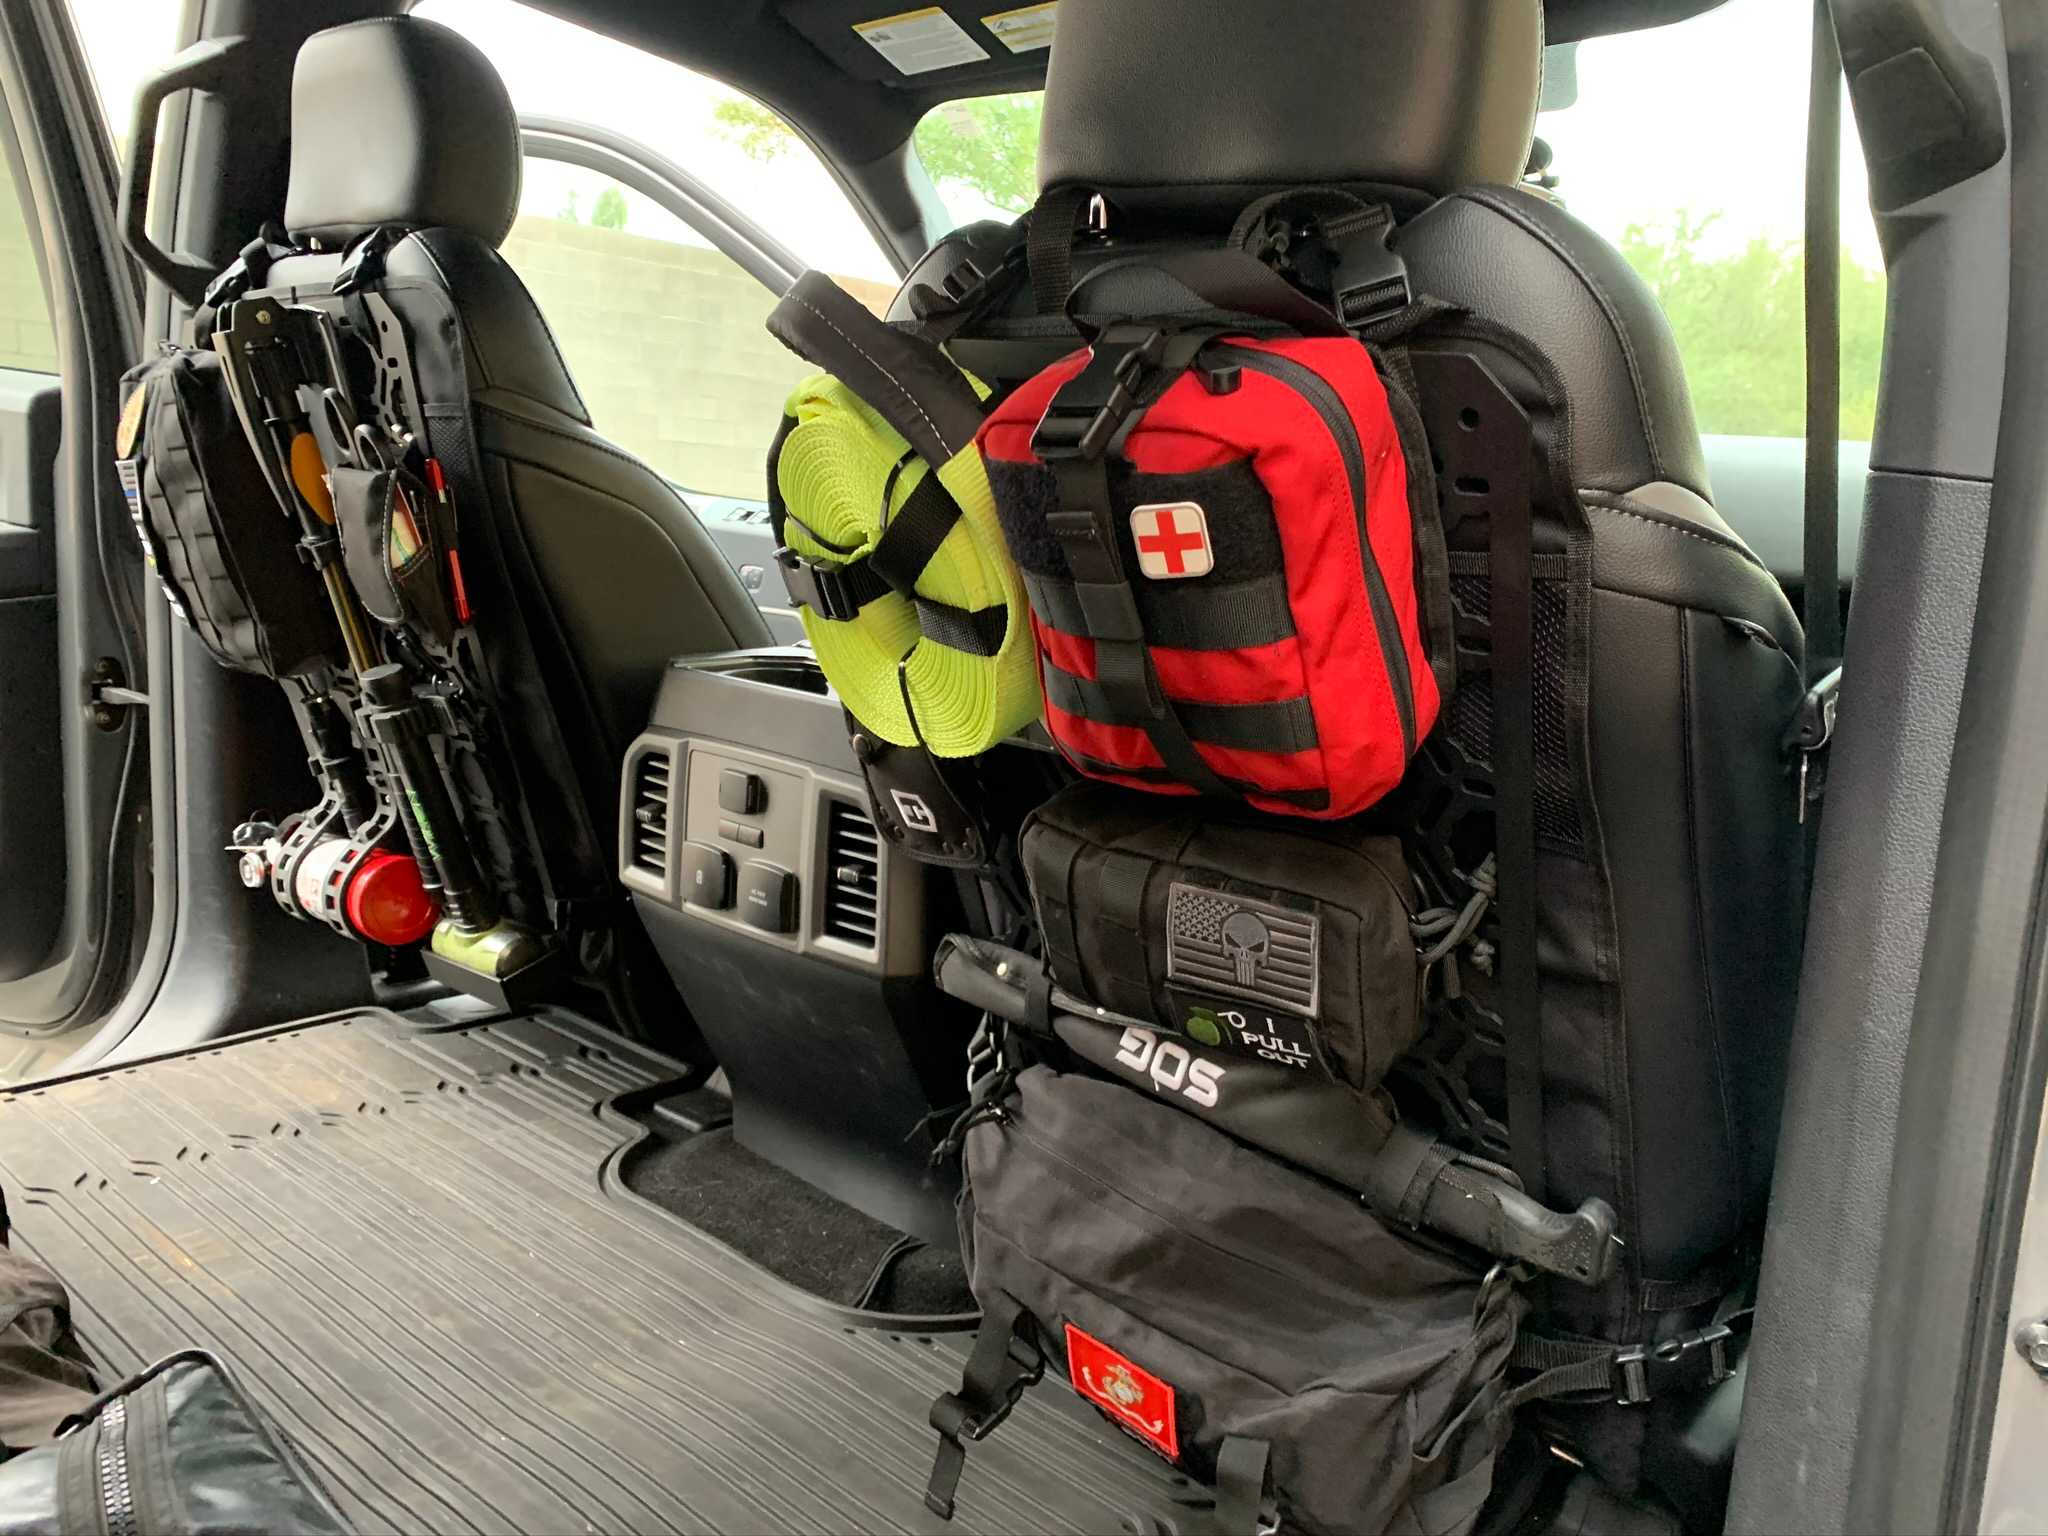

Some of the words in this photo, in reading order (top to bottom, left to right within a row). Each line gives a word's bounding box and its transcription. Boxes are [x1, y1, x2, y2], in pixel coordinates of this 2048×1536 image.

[1241, 1031, 1312, 1058] PULL
[1114, 1026, 1226, 1108] SOG
[1257, 1049, 1308, 1069] OUT
